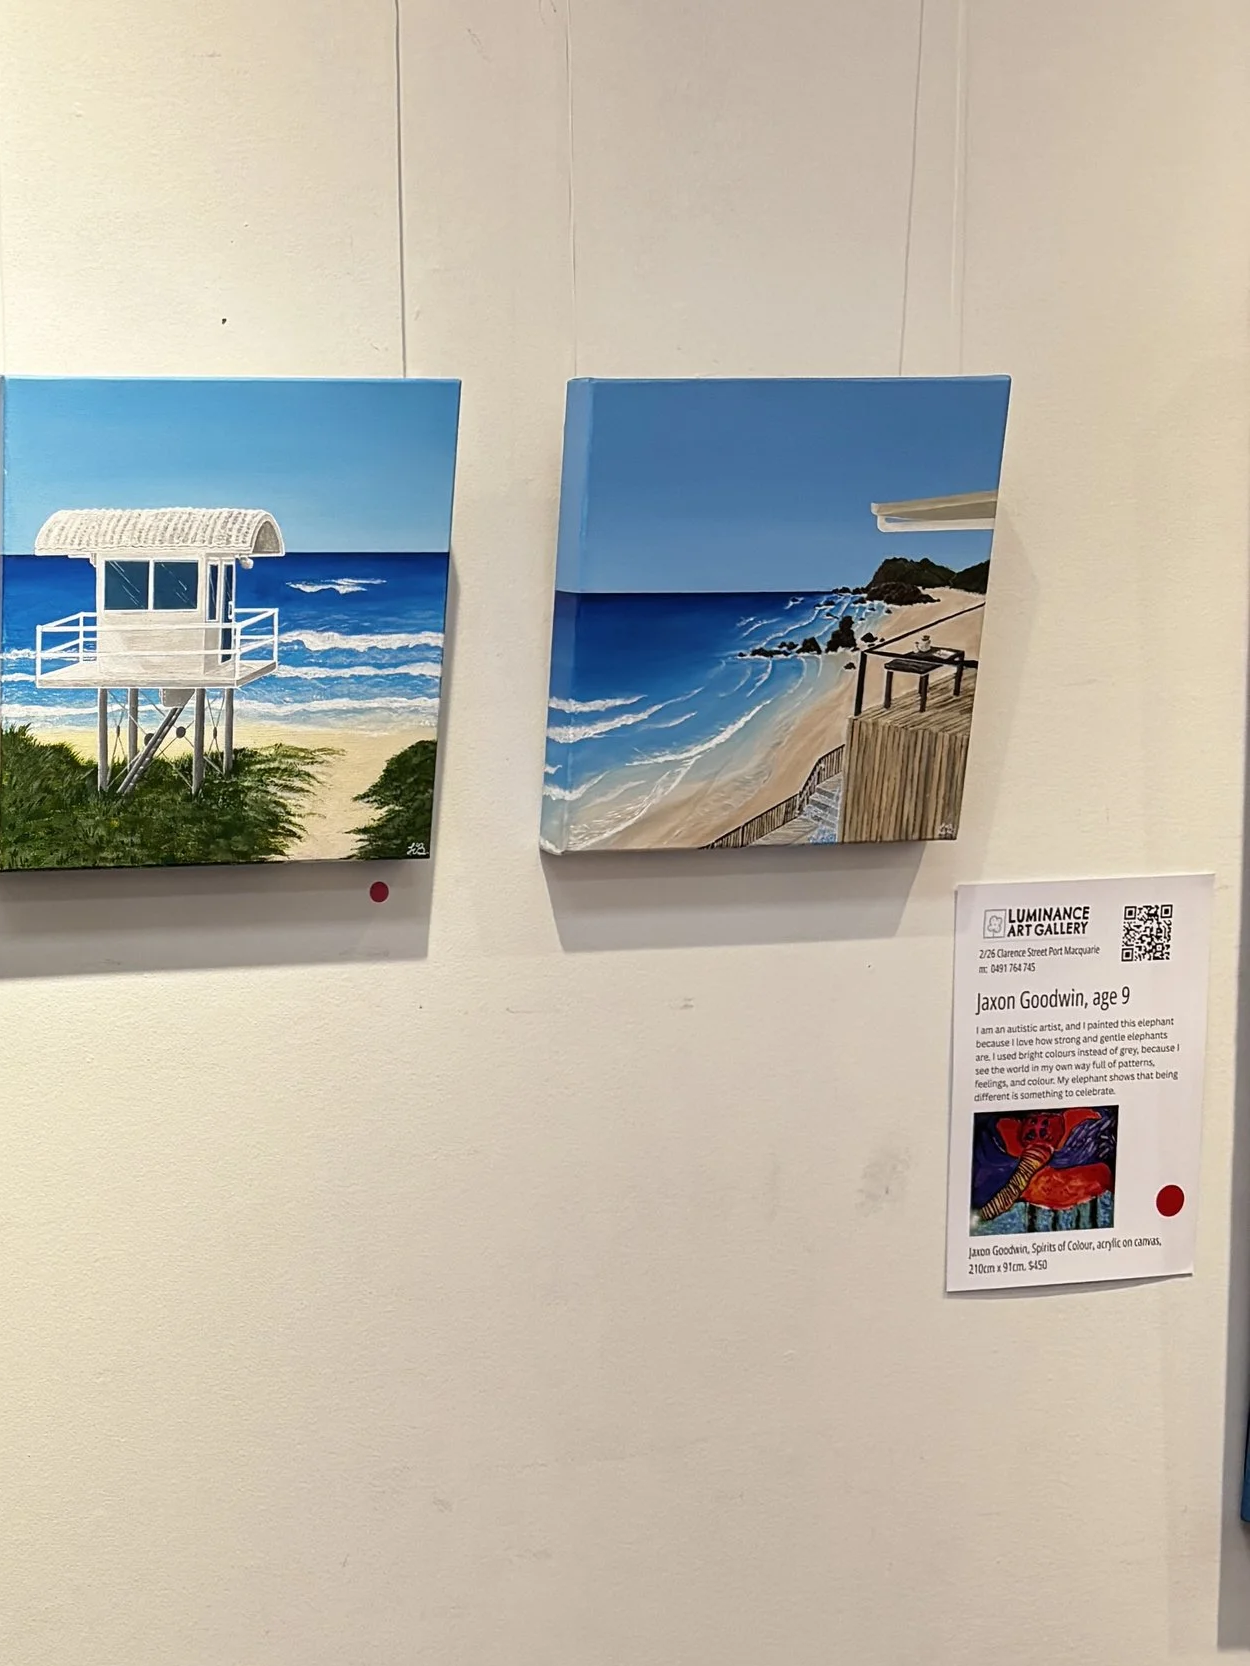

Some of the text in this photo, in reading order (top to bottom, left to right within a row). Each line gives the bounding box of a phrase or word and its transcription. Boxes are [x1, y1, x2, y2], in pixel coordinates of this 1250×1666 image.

[1008, 907, 1090, 923] LUMINANCE
[1006, 922, 1088, 937] ART GALLERY
[978, 945, 1100, 959] 2/26 Clarence Street Port Macquarie
[990, 962, 1035, 973] 0491 764 745
[974, 992, 1015, 1015] Jaxon
[1092, 991, 1117, 1011] age
[1121, 986, 1130, 1004] 9
[1006, 1023, 1037, 1033] autistic
[1064, 1021, 1081, 1030] and
[1086, 1019, 1119, 1031] painted
[1120, 1019, 1136, 1028] this
[1137, 1018, 1174, 1028] elephant
[975, 1031, 1168, 1048] because love how strong and gentle elephants
[996, 1051, 1017, 1060] used
[1018, 1050, 1043, 1061] bright
[1044, 1049, 1076, 1058] colours
[1077, 1047, 1108, 1056] instead
[1140, 1045, 1175, 1053] because
[974, 1067, 989, 1075] see
[990, 1066, 1005, 1074] the
[1006, 1064, 1030, 1073] world
[1054, 1063, 1073, 1071] own
[1073, 1062, 1091, 1072] way
[1092, 1060, 1106, 1069] full
[1009, 1071, 1178, 1087] and elephant shows that being
[973, 1089, 1063, 1102] different something
[968, 1239, 1121, 1259] Jaxon Spirits acrylic
[968, 1260, 1047, 1275] 210cm $450
